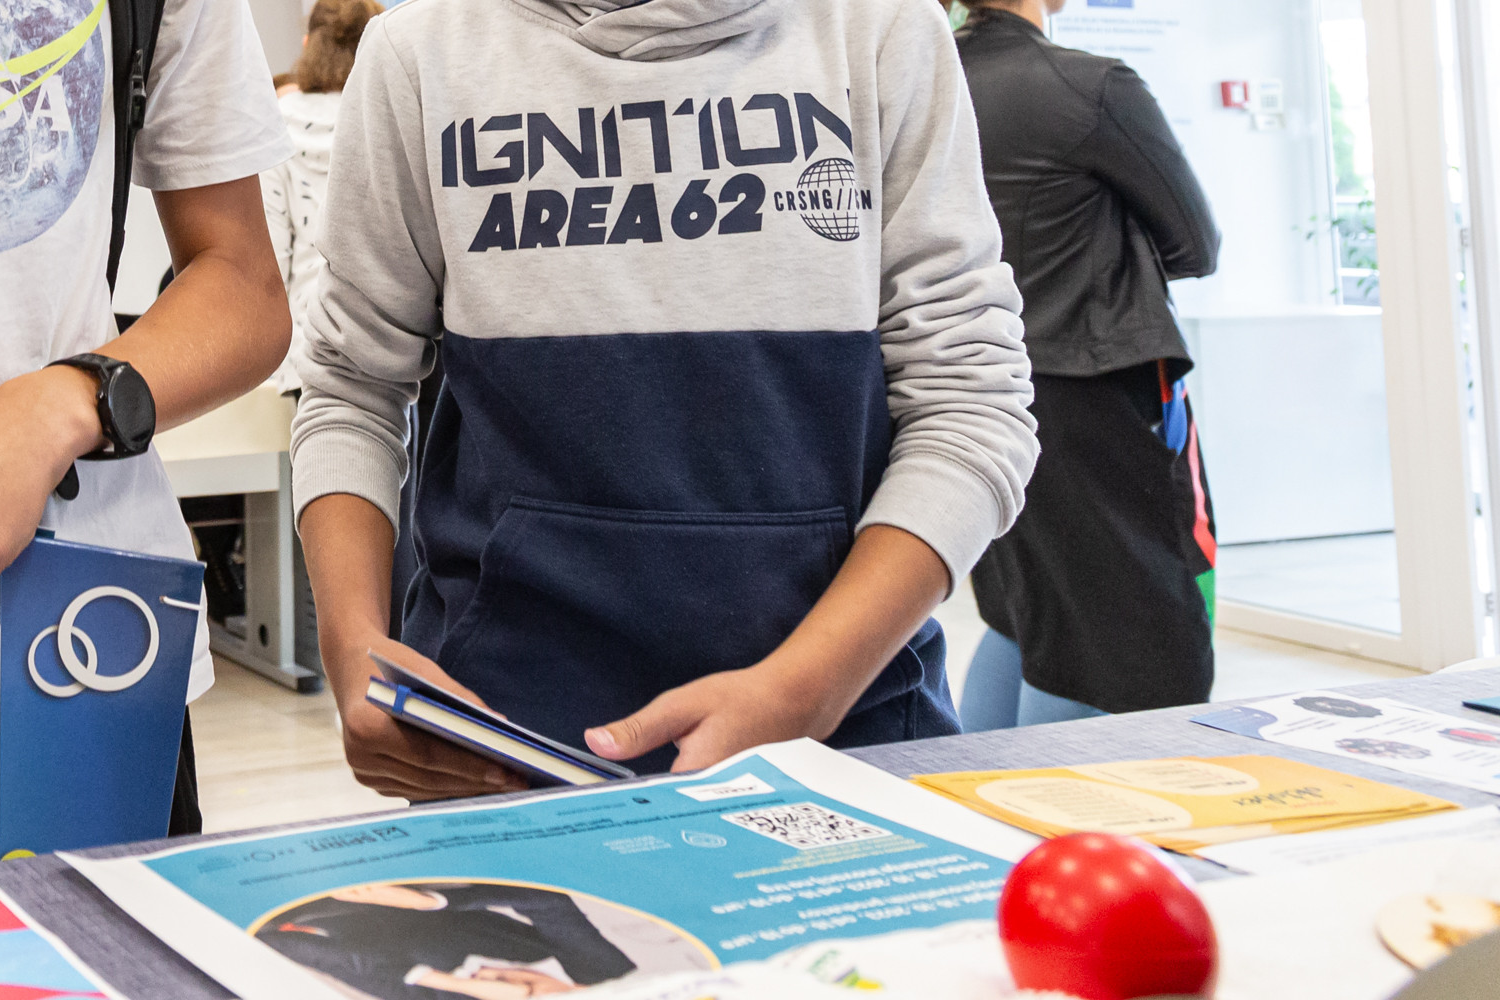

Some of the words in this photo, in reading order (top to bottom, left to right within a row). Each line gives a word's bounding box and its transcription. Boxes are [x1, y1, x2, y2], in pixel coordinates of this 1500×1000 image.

[442, 87, 853, 188] IGNITION
[468, 183, 663, 253] AREA
[671, 173, 766, 240] 62
